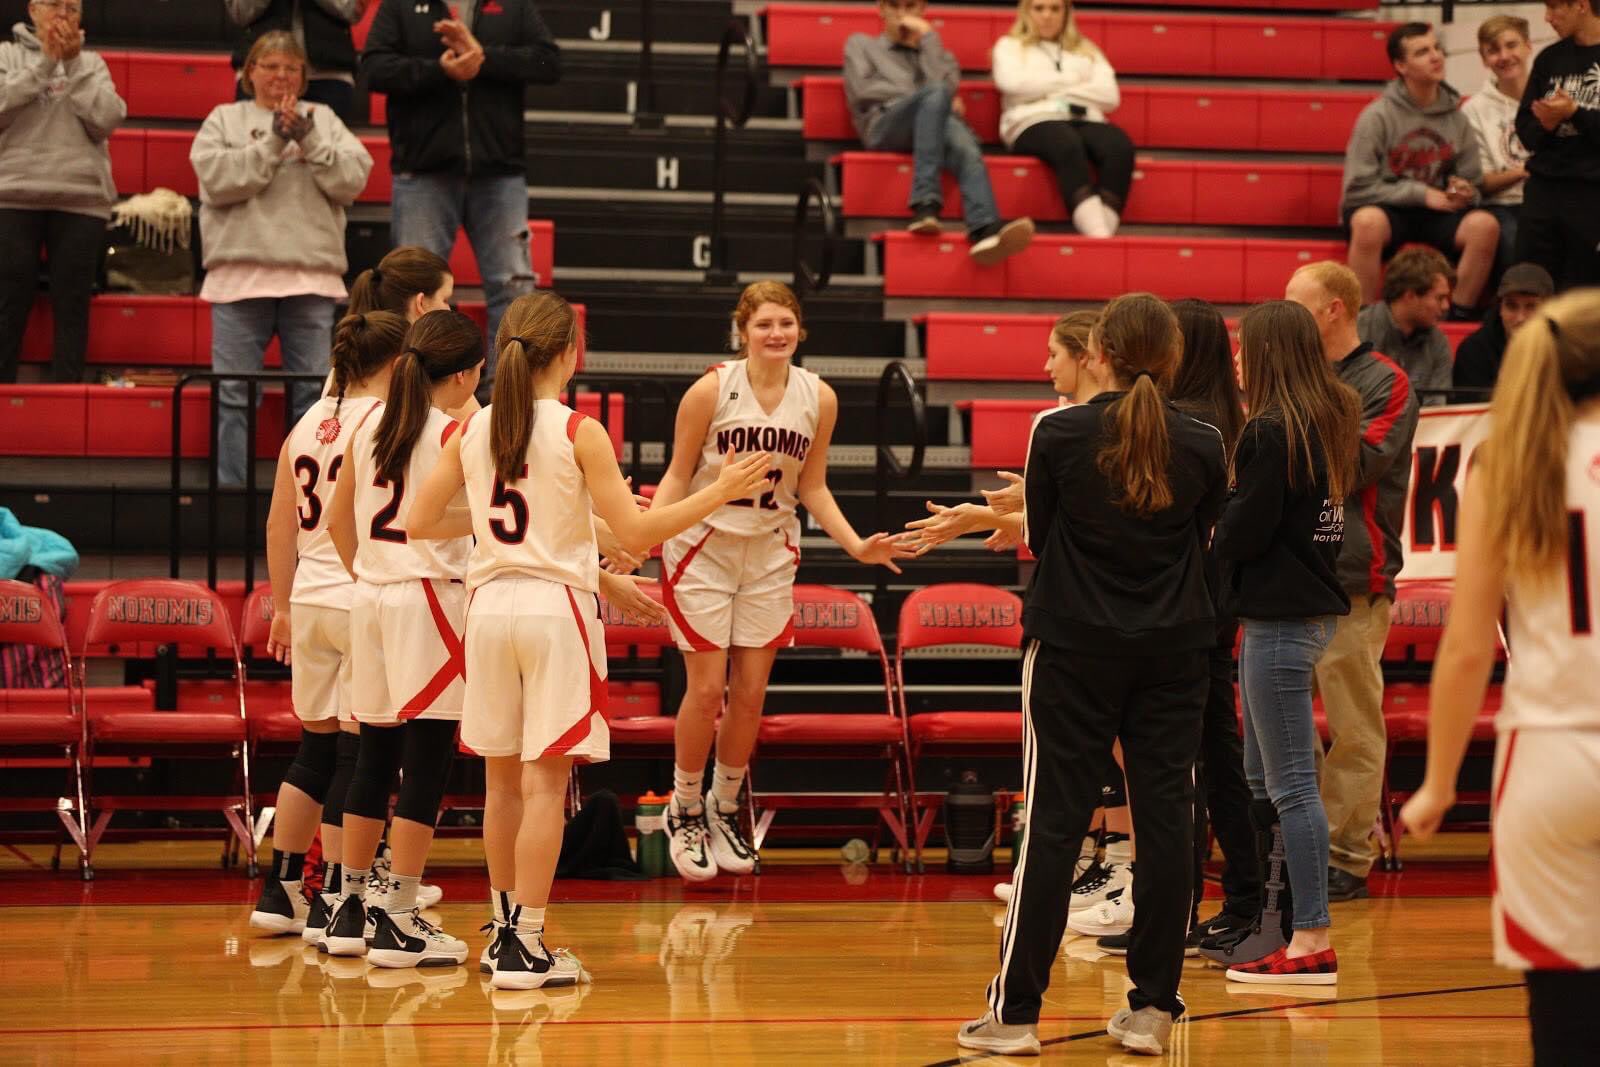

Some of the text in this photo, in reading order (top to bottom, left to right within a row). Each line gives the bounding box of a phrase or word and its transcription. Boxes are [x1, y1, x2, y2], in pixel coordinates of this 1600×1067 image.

[589, 10, 611, 40] J
[626, 81, 637, 114] I
[656, 157, 679, 189] H
[692, 235, 711, 268] G
[716, 426, 810, 462] NOKOMIS
[294, 454, 344, 532] 3
[370, 470, 408, 545] 2
[488, 463, 530, 546] 5
[108, 596, 213, 625] NOKOMIS
[920, 602, 1016, 628] NOKOMIS
